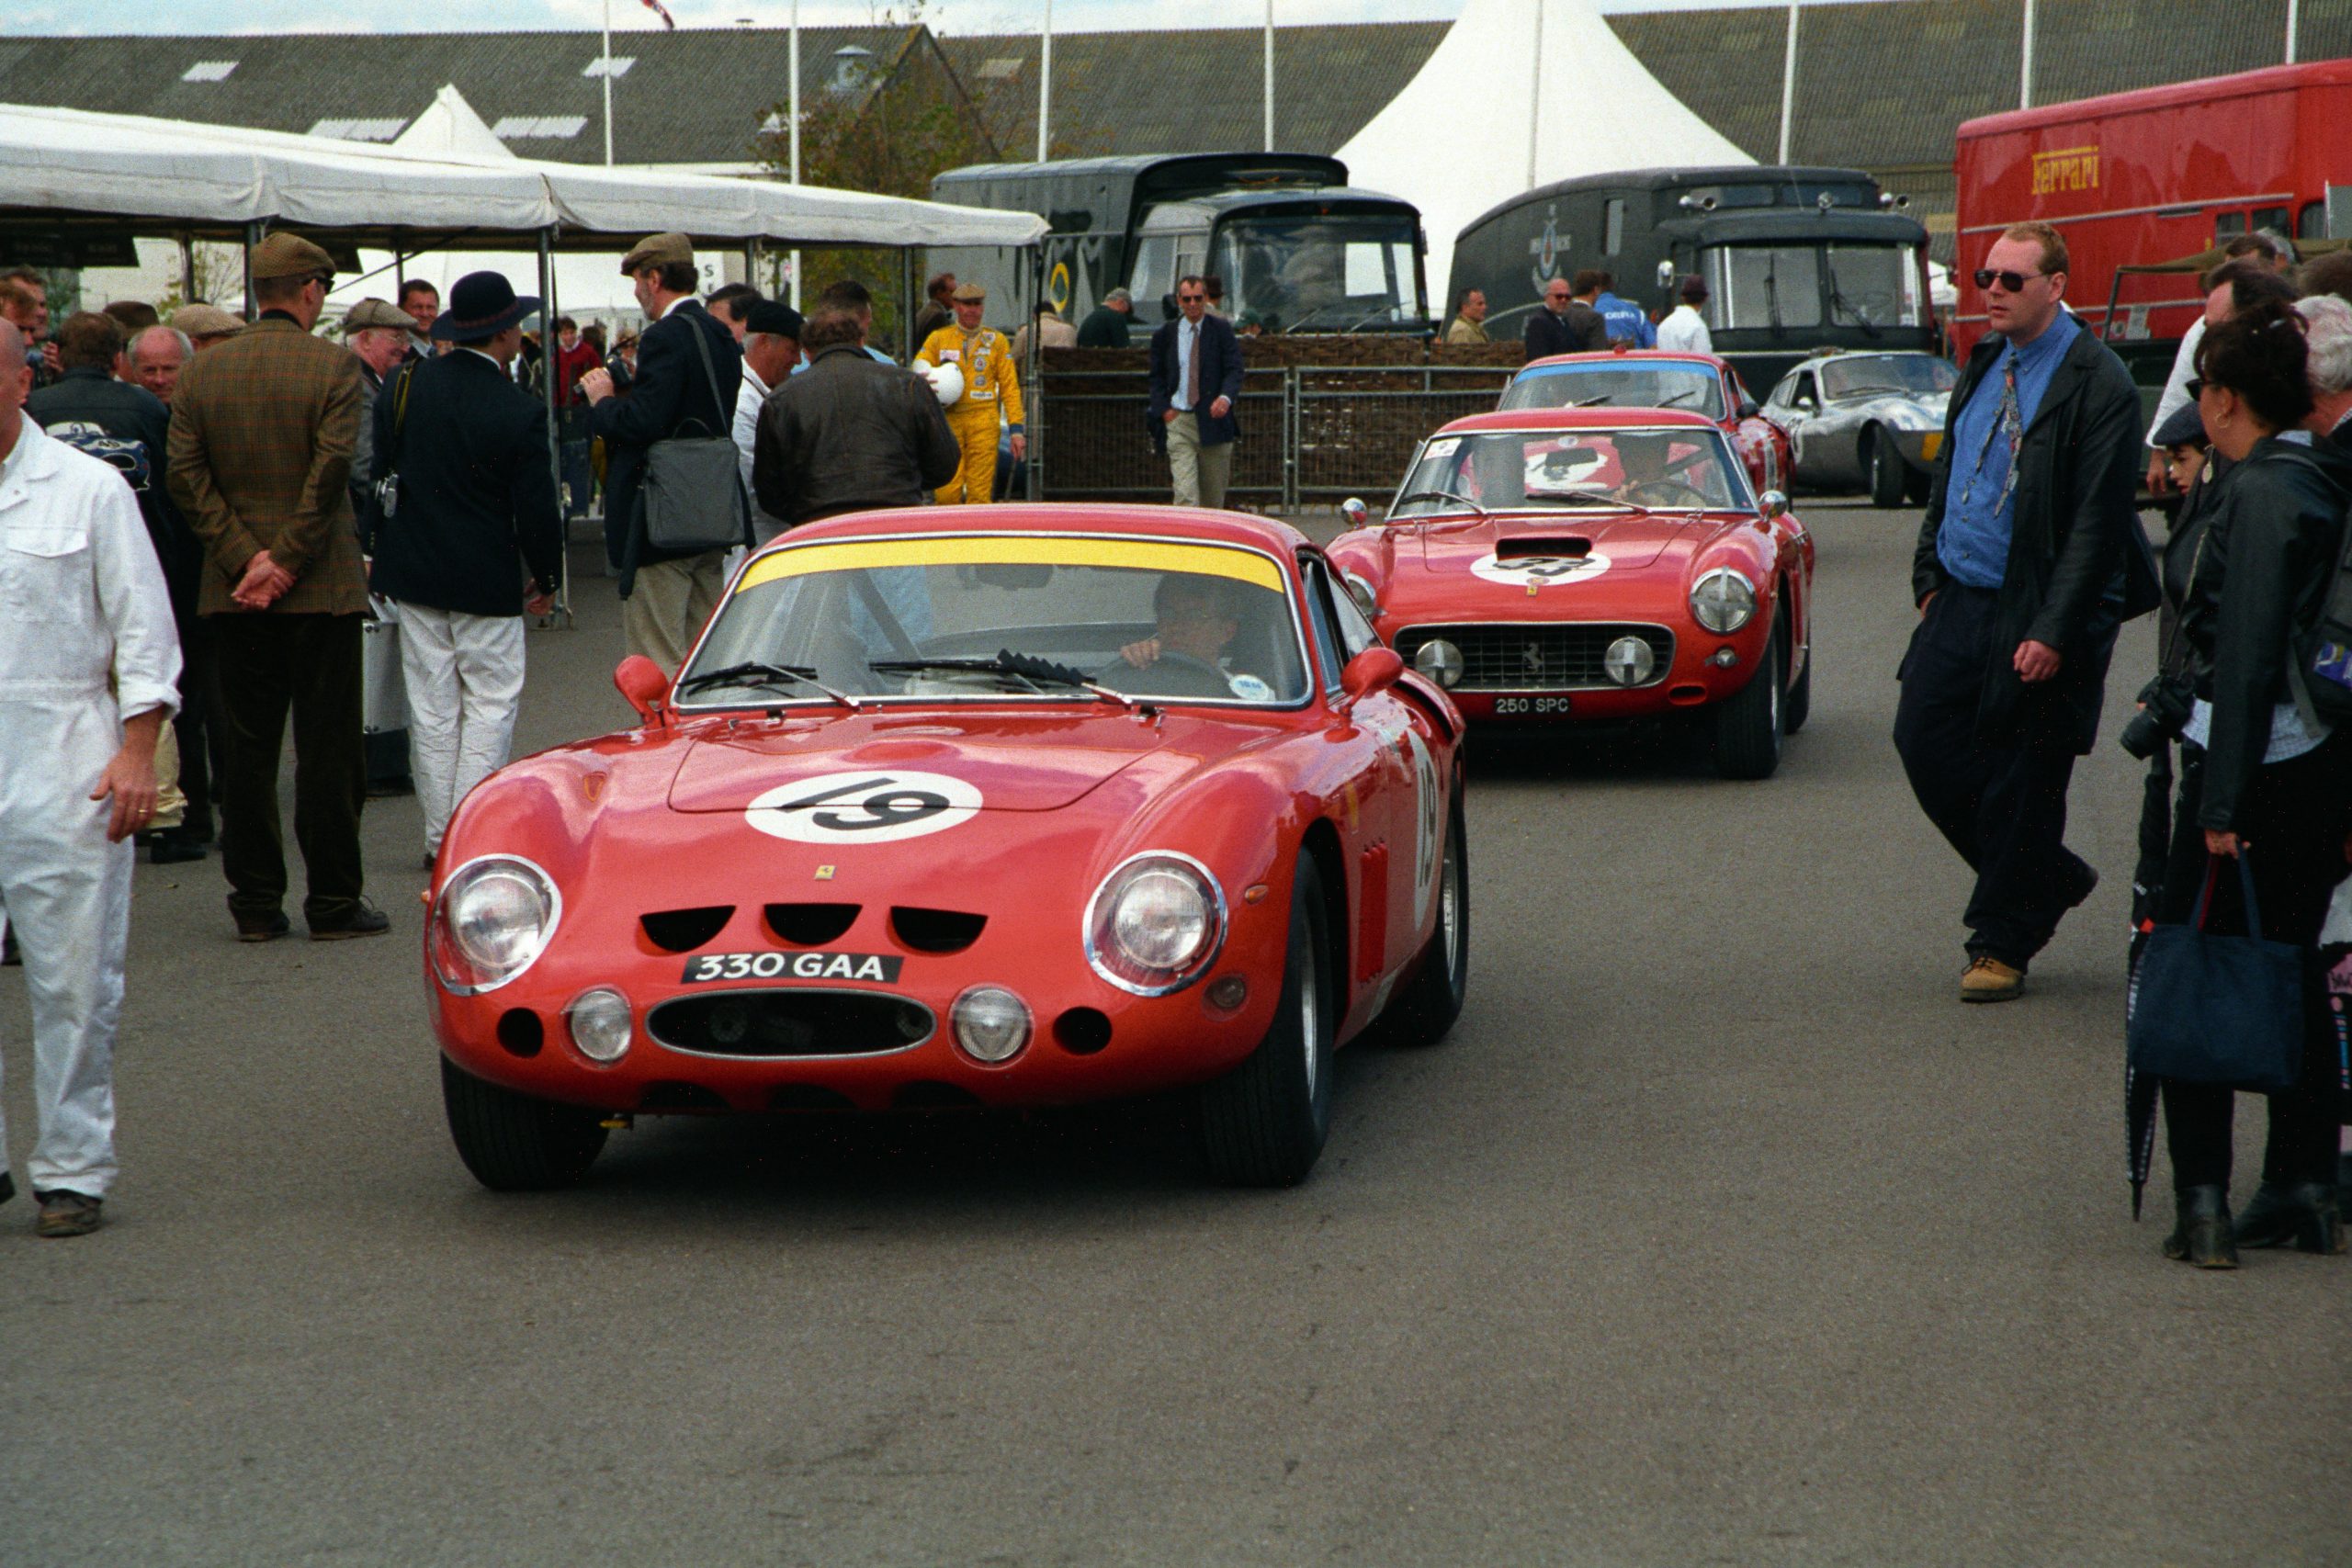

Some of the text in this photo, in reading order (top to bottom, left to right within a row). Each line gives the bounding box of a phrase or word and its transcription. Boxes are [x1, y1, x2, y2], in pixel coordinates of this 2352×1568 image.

[2031, 145, 2099, 195] Ferrari
[1497, 698, 1568, 713] 250 SPC
[774, 777, 951, 830] 19
[695, 953, 885, 981] 330 GAA
